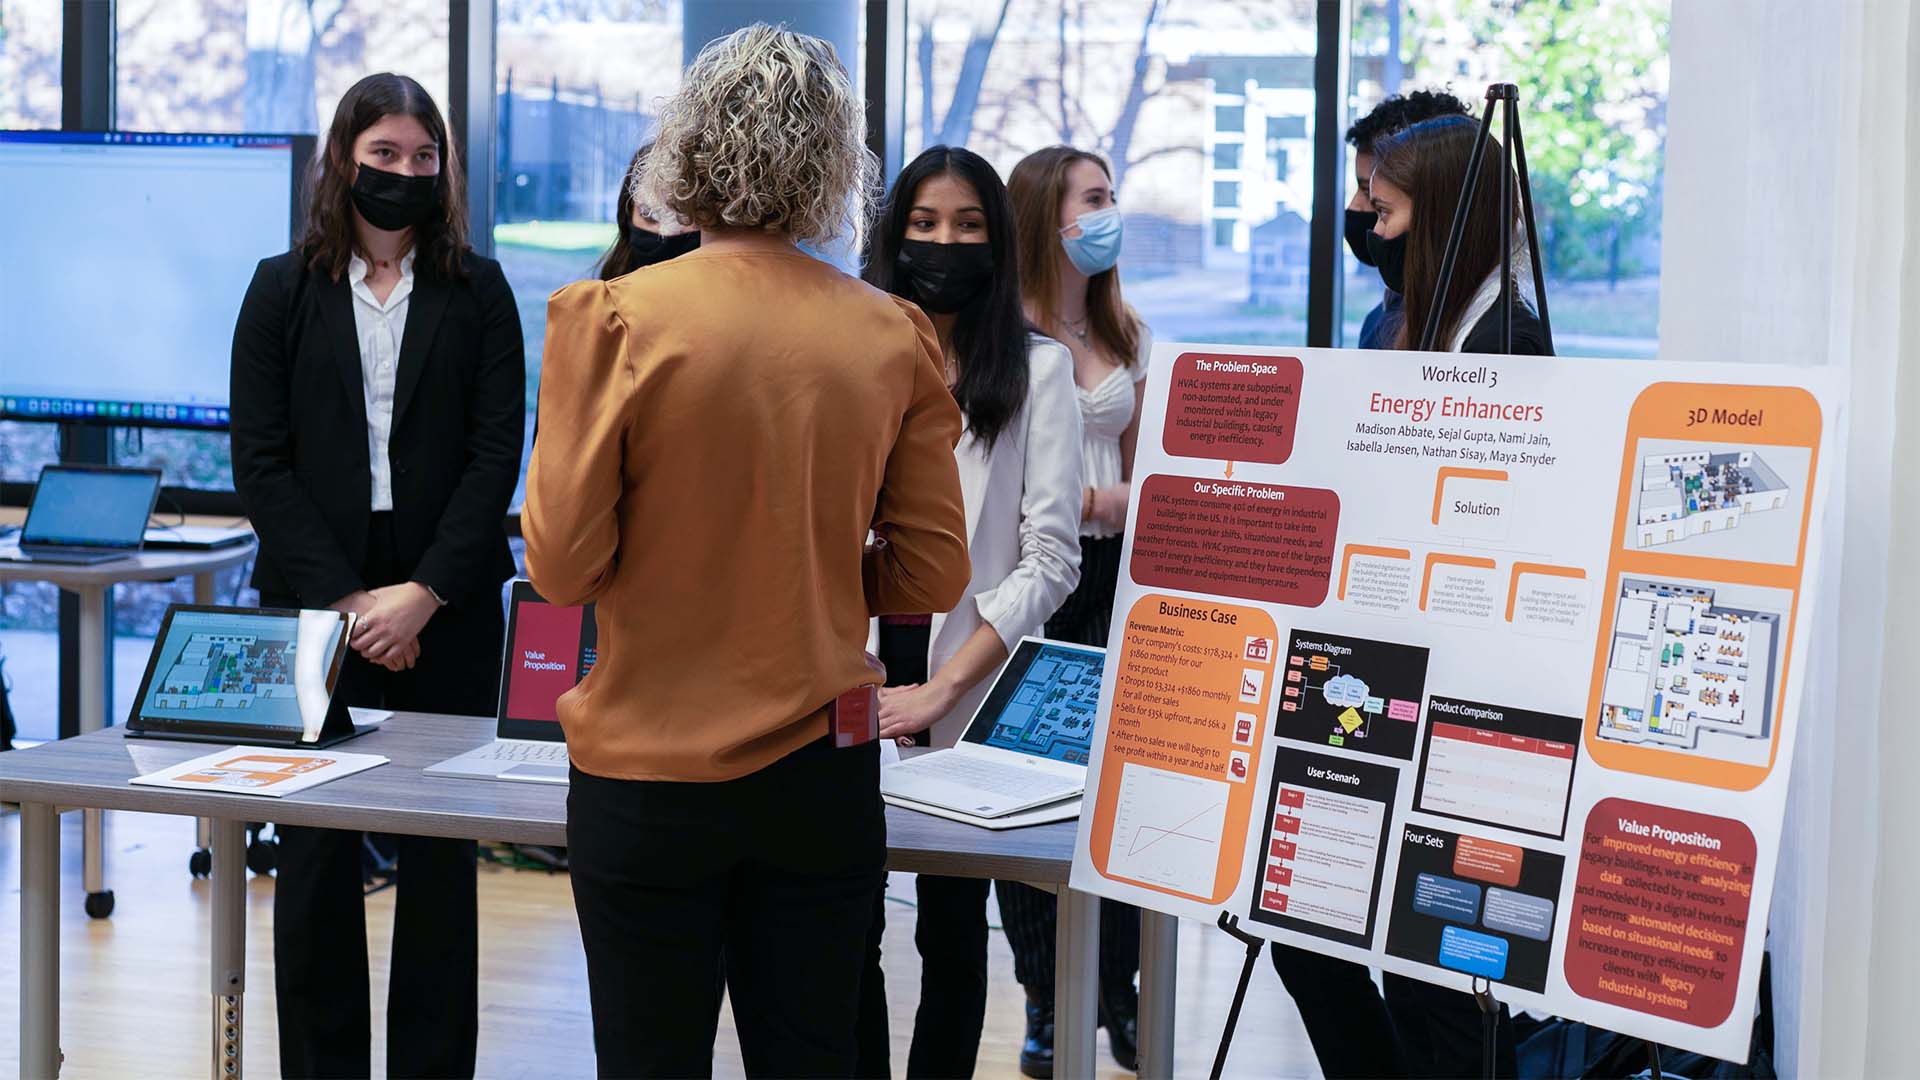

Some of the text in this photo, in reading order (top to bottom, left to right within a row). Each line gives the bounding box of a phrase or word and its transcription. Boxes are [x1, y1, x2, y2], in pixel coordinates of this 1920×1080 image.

[1195, 360, 1277, 375] The Problem Space
[1420, 366, 1498, 387] Workcell 3
[1369, 392, 1544, 422] Energy Enhancers
[1687, 408, 1762, 426] 3D Model
[1355, 423, 1550, 447] Madison Abbate, Sejal Gupta, Nami Jain,
[1346, 440, 1556, 466] Isabella Jensen, Nathan Sisay, Maya Snyder
[1193, 482, 1284, 500] Our Specific Problem
[1454, 501, 1500, 516] Solution
[1159, 601, 1237, 624] Business Case
[1129, 621, 1184, 636] Revenue Matrix:
[1131, 635, 1144, 645] Our
[1145, 639, 1181, 652] company's
[1182, 645, 1202, 653] costs:
[1295, 639, 1352, 655] Systems Diagram
[525, 651, 545, 659] Value
[1129, 648, 1148, 659] $1860
[1149, 654, 1177, 666] monthly
[1178, 656, 1188, 665] for
[524, 661, 565, 671] Proposition
[1127, 662, 1168, 676] first product
[1122, 689, 1179, 706] for all other sales
[1125, 675, 1145, 688] Drops
[1201, 690, 1231, 704] monthly
[1120, 703, 1221, 728] Sells $35k upfront, $6k
[1430, 700, 1459, 714] Product
[1459, 705, 1503, 721] Comparison
[1118, 718, 1140, 727] month
[1116, 729, 1211, 756] After two sales will begin
[1113, 745, 1224, 772] see profit within year half.
[1306, 766, 1360, 785] User Scenario
[1404, 830, 1444, 848] Four Sets
[1617, 818, 1721, 850] Value Proposition
[1603, 835, 1651, 855] improved
[1689, 853, 1740, 875] efficiency
[1599, 870, 1622, 885] data
[1700, 875, 1751, 897] analyzing
[1582, 919, 1611, 936] based
[1627, 930, 1681, 952] situational
[1682, 945, 1714, 960] needs
[1629, 915, 1684, 935] automated
[1686, 925, 1733, 946] decisions
[1658, 956, 1708, 979] efficiency
[1598, 977, 1645, 998] industrial
